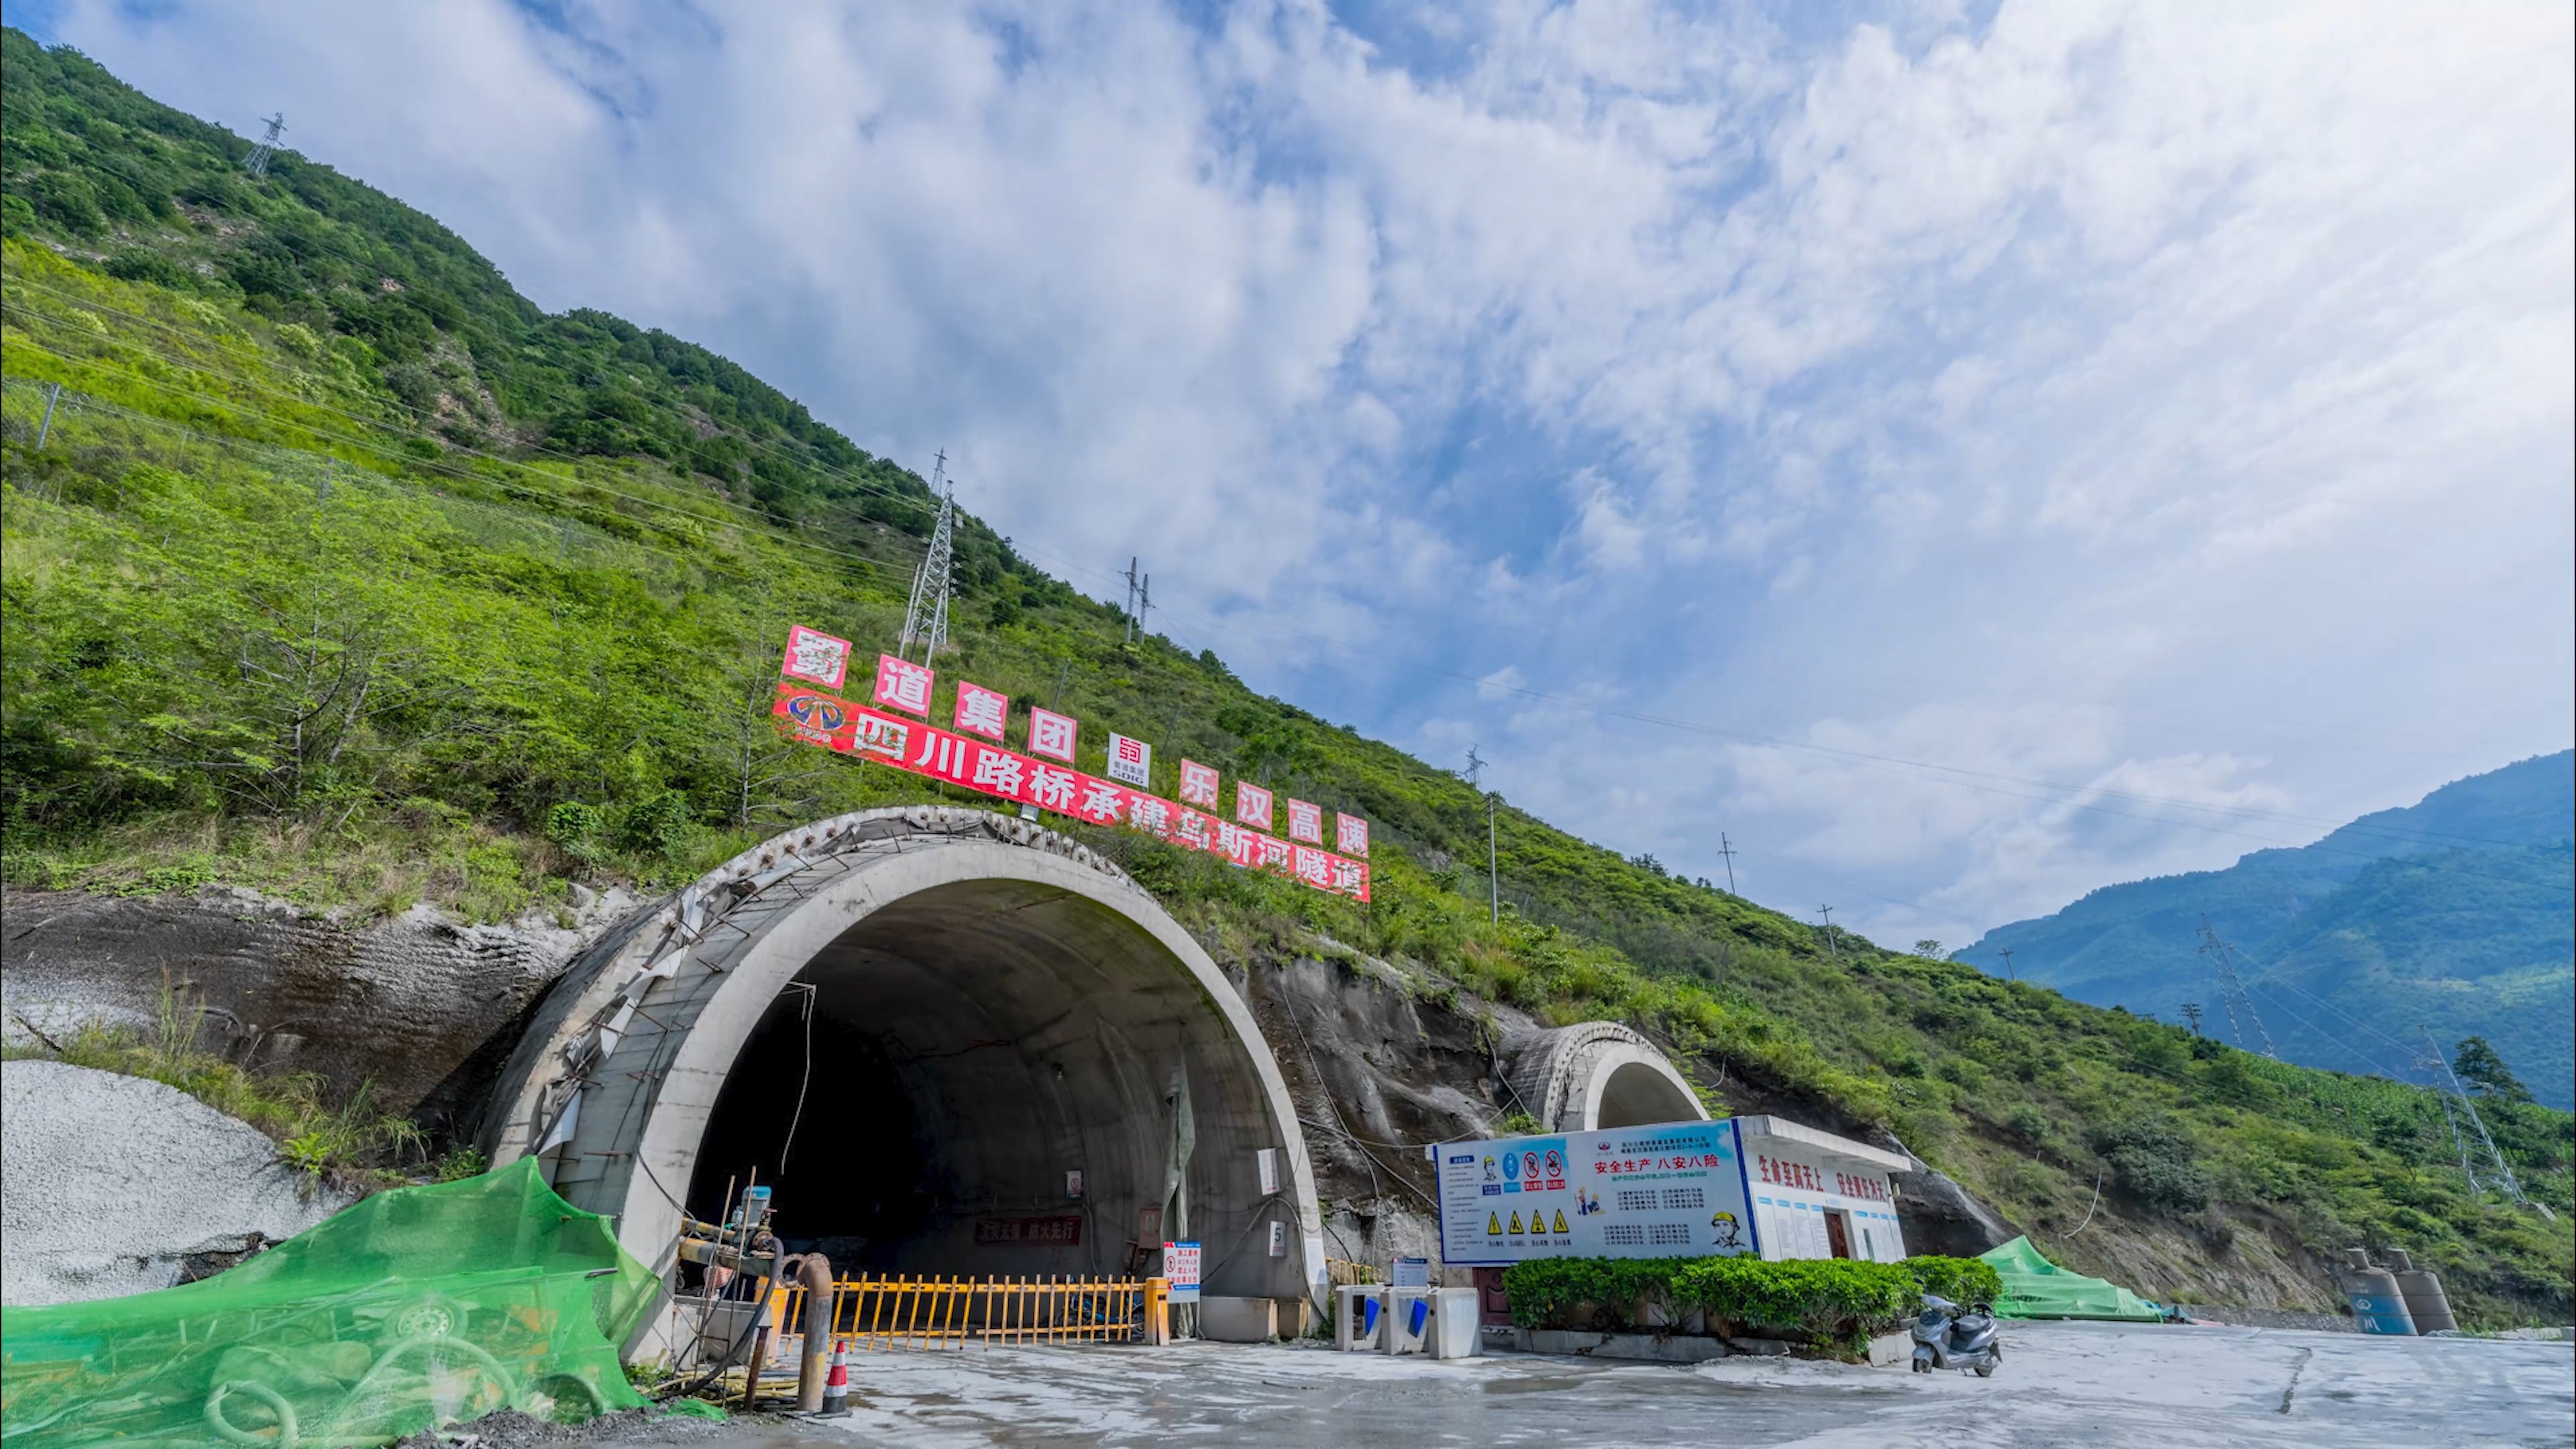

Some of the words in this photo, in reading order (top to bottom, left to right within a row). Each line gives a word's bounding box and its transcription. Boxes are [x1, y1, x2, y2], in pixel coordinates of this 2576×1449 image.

[1114, 770, 1144, 784] SDIG
[1182, 765, 1366, 854] 乐汉高速
[1595, 1159, 1651, 1174] 安全生产
[1658, 1154, 1719, 1169] 八安八险
[1759, 1155, 1824, 1192] 生命至高无上
[1837, 1172, 1886, 1201] 安全责任为天
[1275, 1227, 1282, 1242] 5
